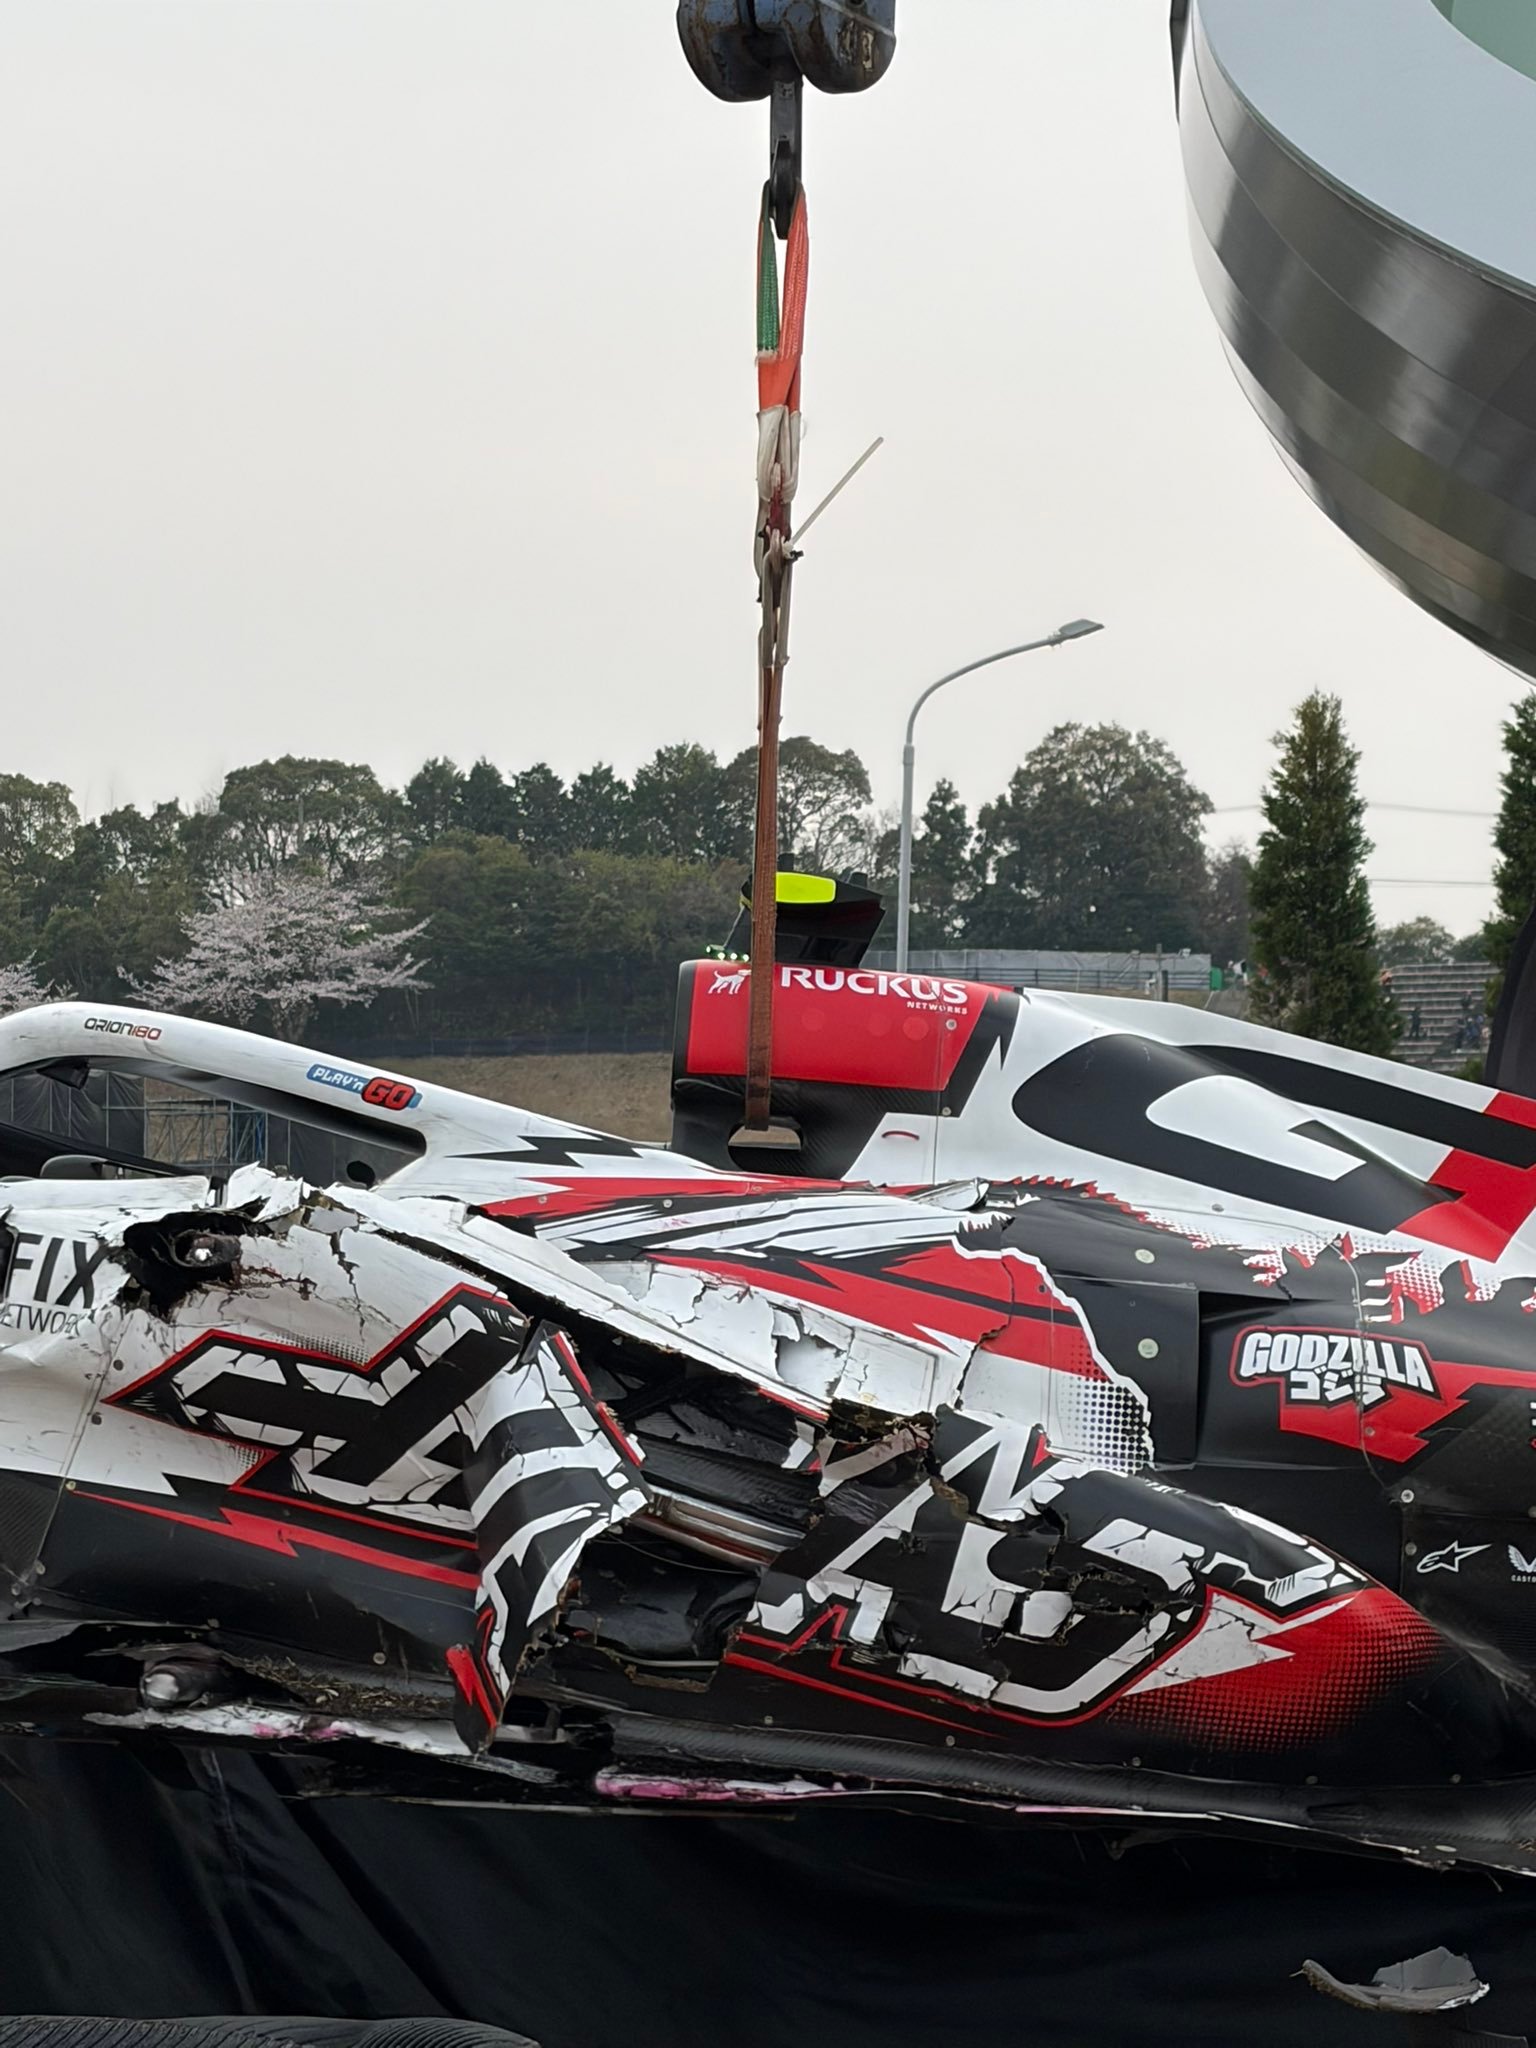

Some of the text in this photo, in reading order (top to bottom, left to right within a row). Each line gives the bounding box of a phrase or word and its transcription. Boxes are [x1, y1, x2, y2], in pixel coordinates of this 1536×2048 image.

[781, 966, 968, 1004] RUCKUS
[906, 1001, 968, 1015] NETWORKS
[363, 1079, 416, 1110] GO
[5, 1232, 107, 1309] FIX
[1240, 1332, 1434, 1393] GODZILLA
